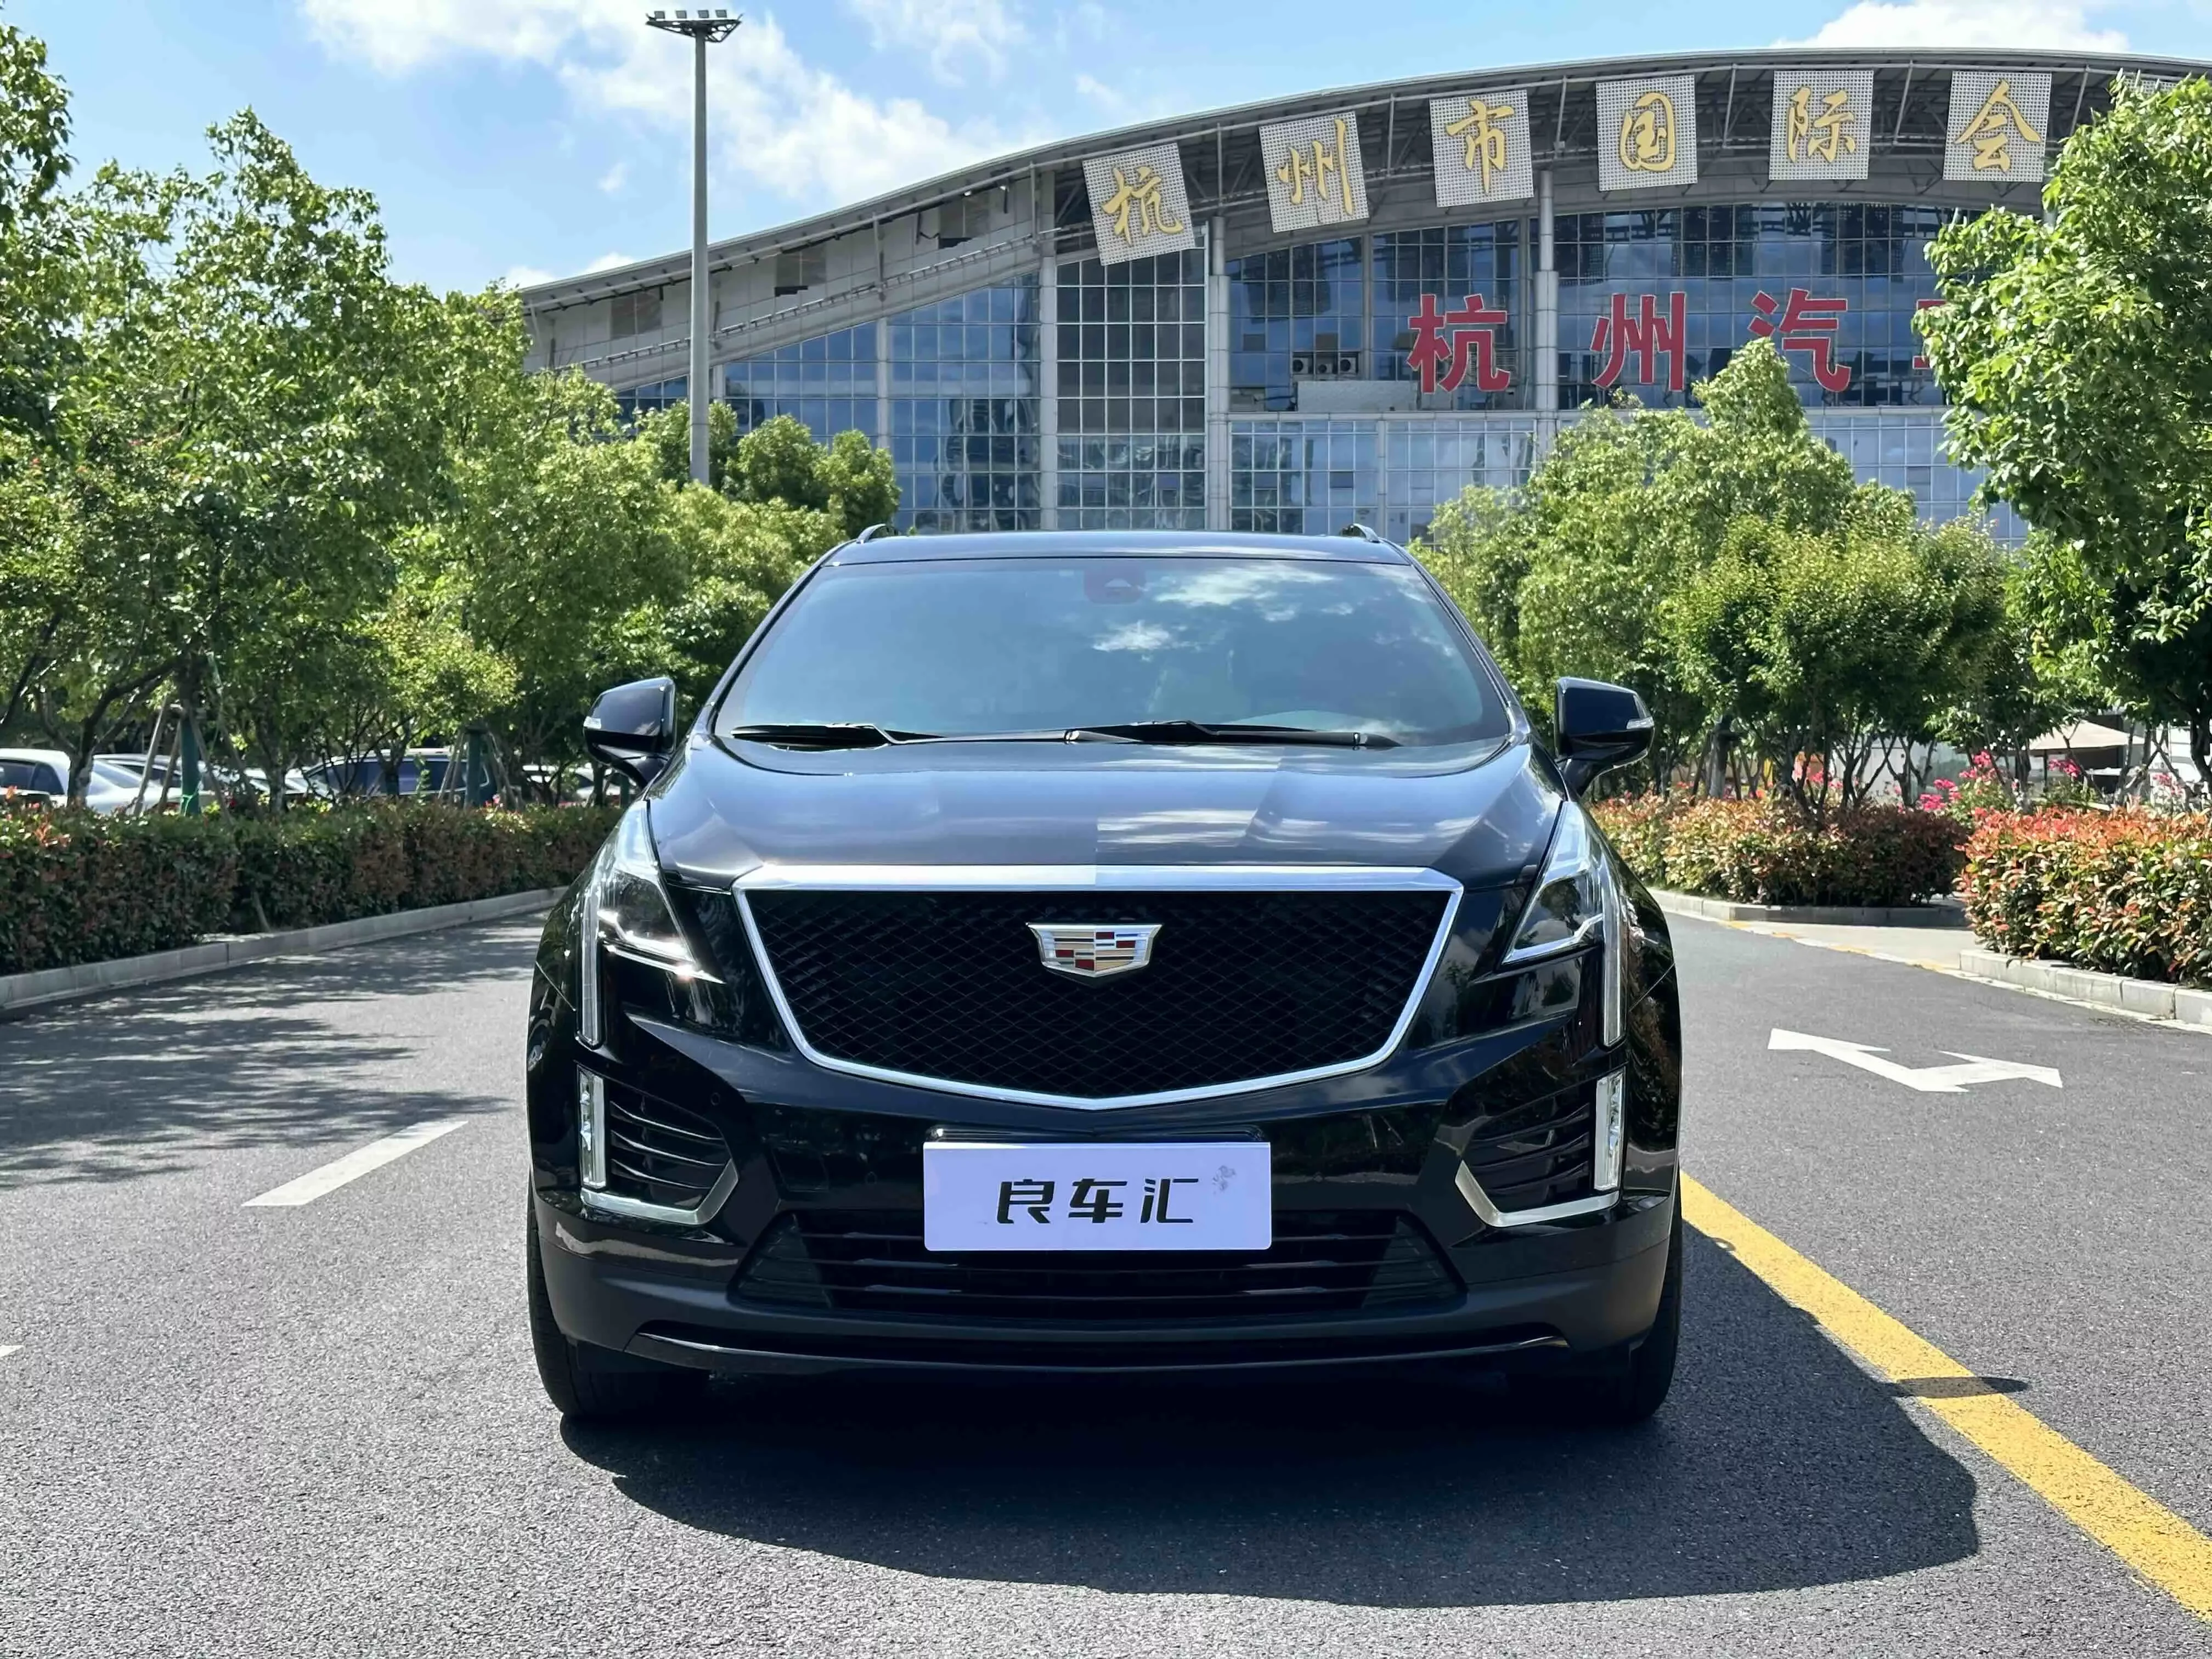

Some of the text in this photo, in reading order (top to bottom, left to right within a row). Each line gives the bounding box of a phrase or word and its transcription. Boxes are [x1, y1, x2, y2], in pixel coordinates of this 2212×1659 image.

[1102, 80, 2040, 246] 杭州市国际会
[1407, 287, 1948, 394] 杭州汽
[996, 1178, 1199, 1224] 良车汇
